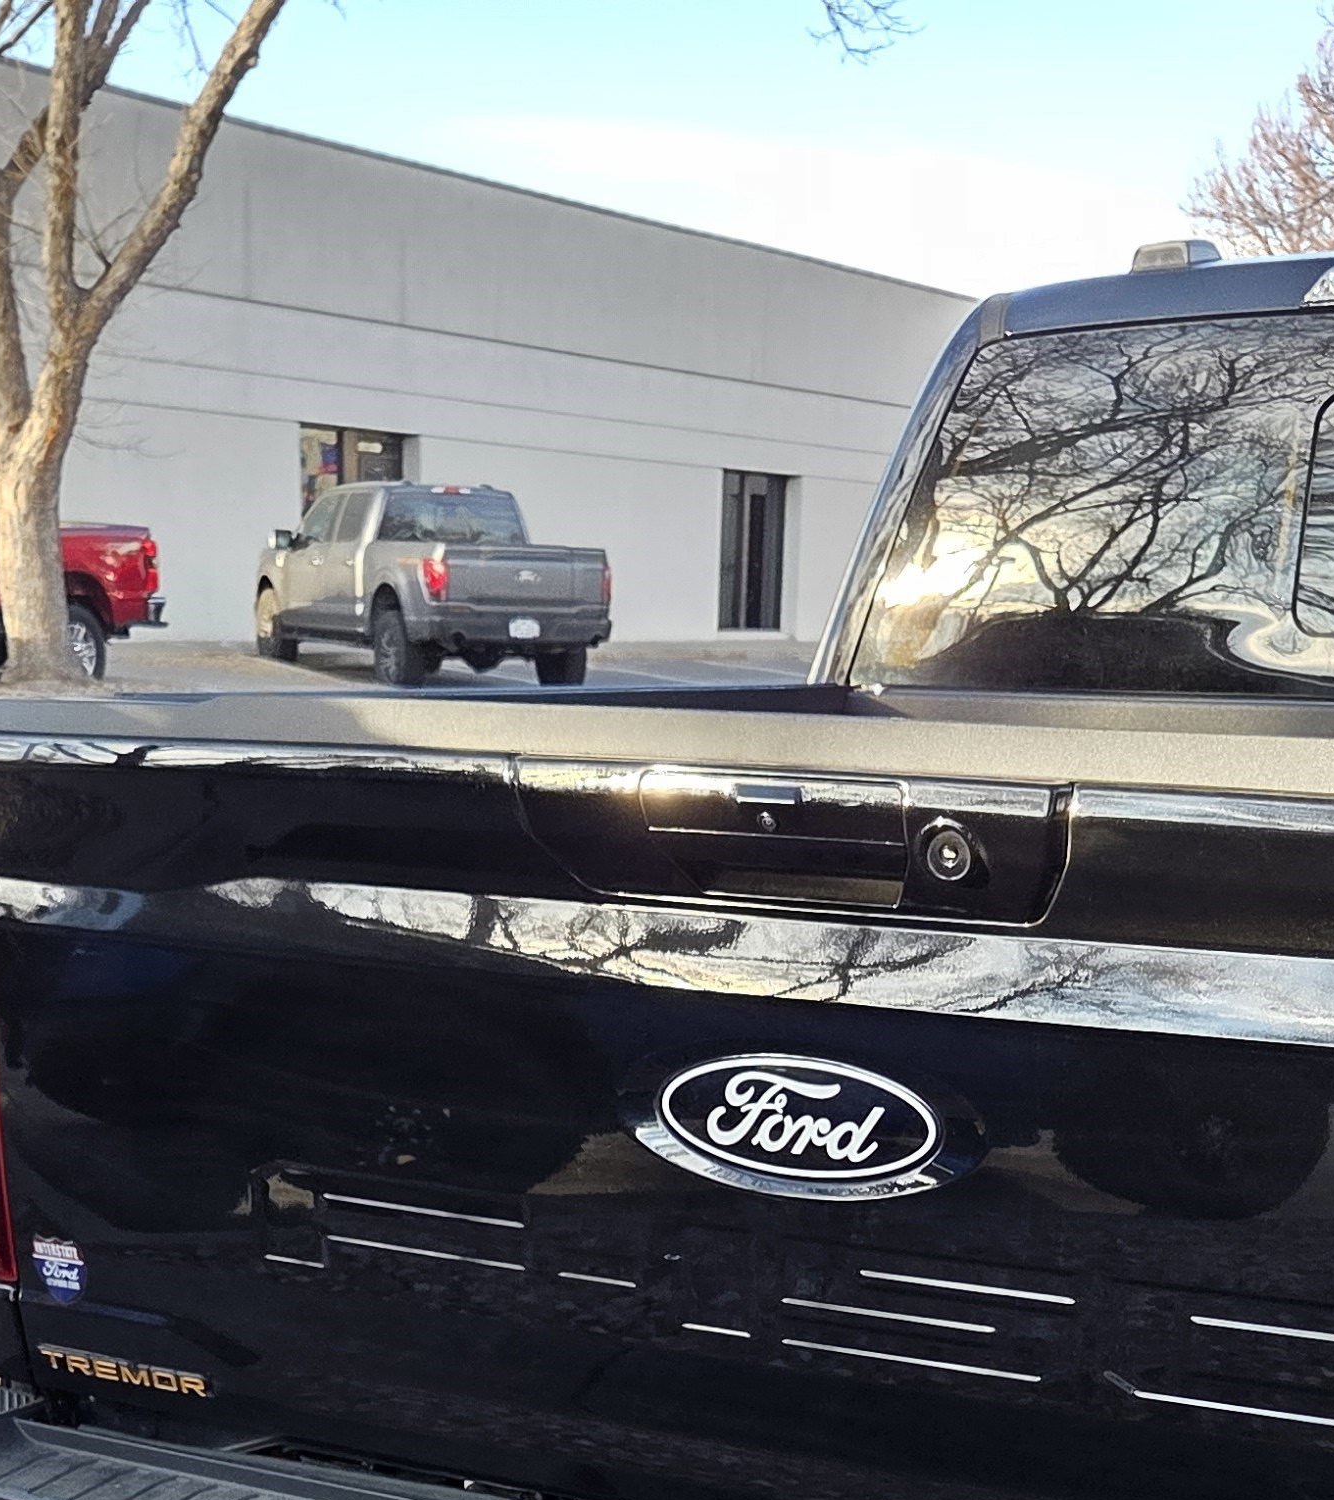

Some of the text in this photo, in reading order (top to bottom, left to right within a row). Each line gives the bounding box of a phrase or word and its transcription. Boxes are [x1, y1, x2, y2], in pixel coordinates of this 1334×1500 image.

[706, 1070, 885, 1163] Ford
[42, 1260, 79, 1281] Ford
[39, 1346, 208, 1398] TREMOR
